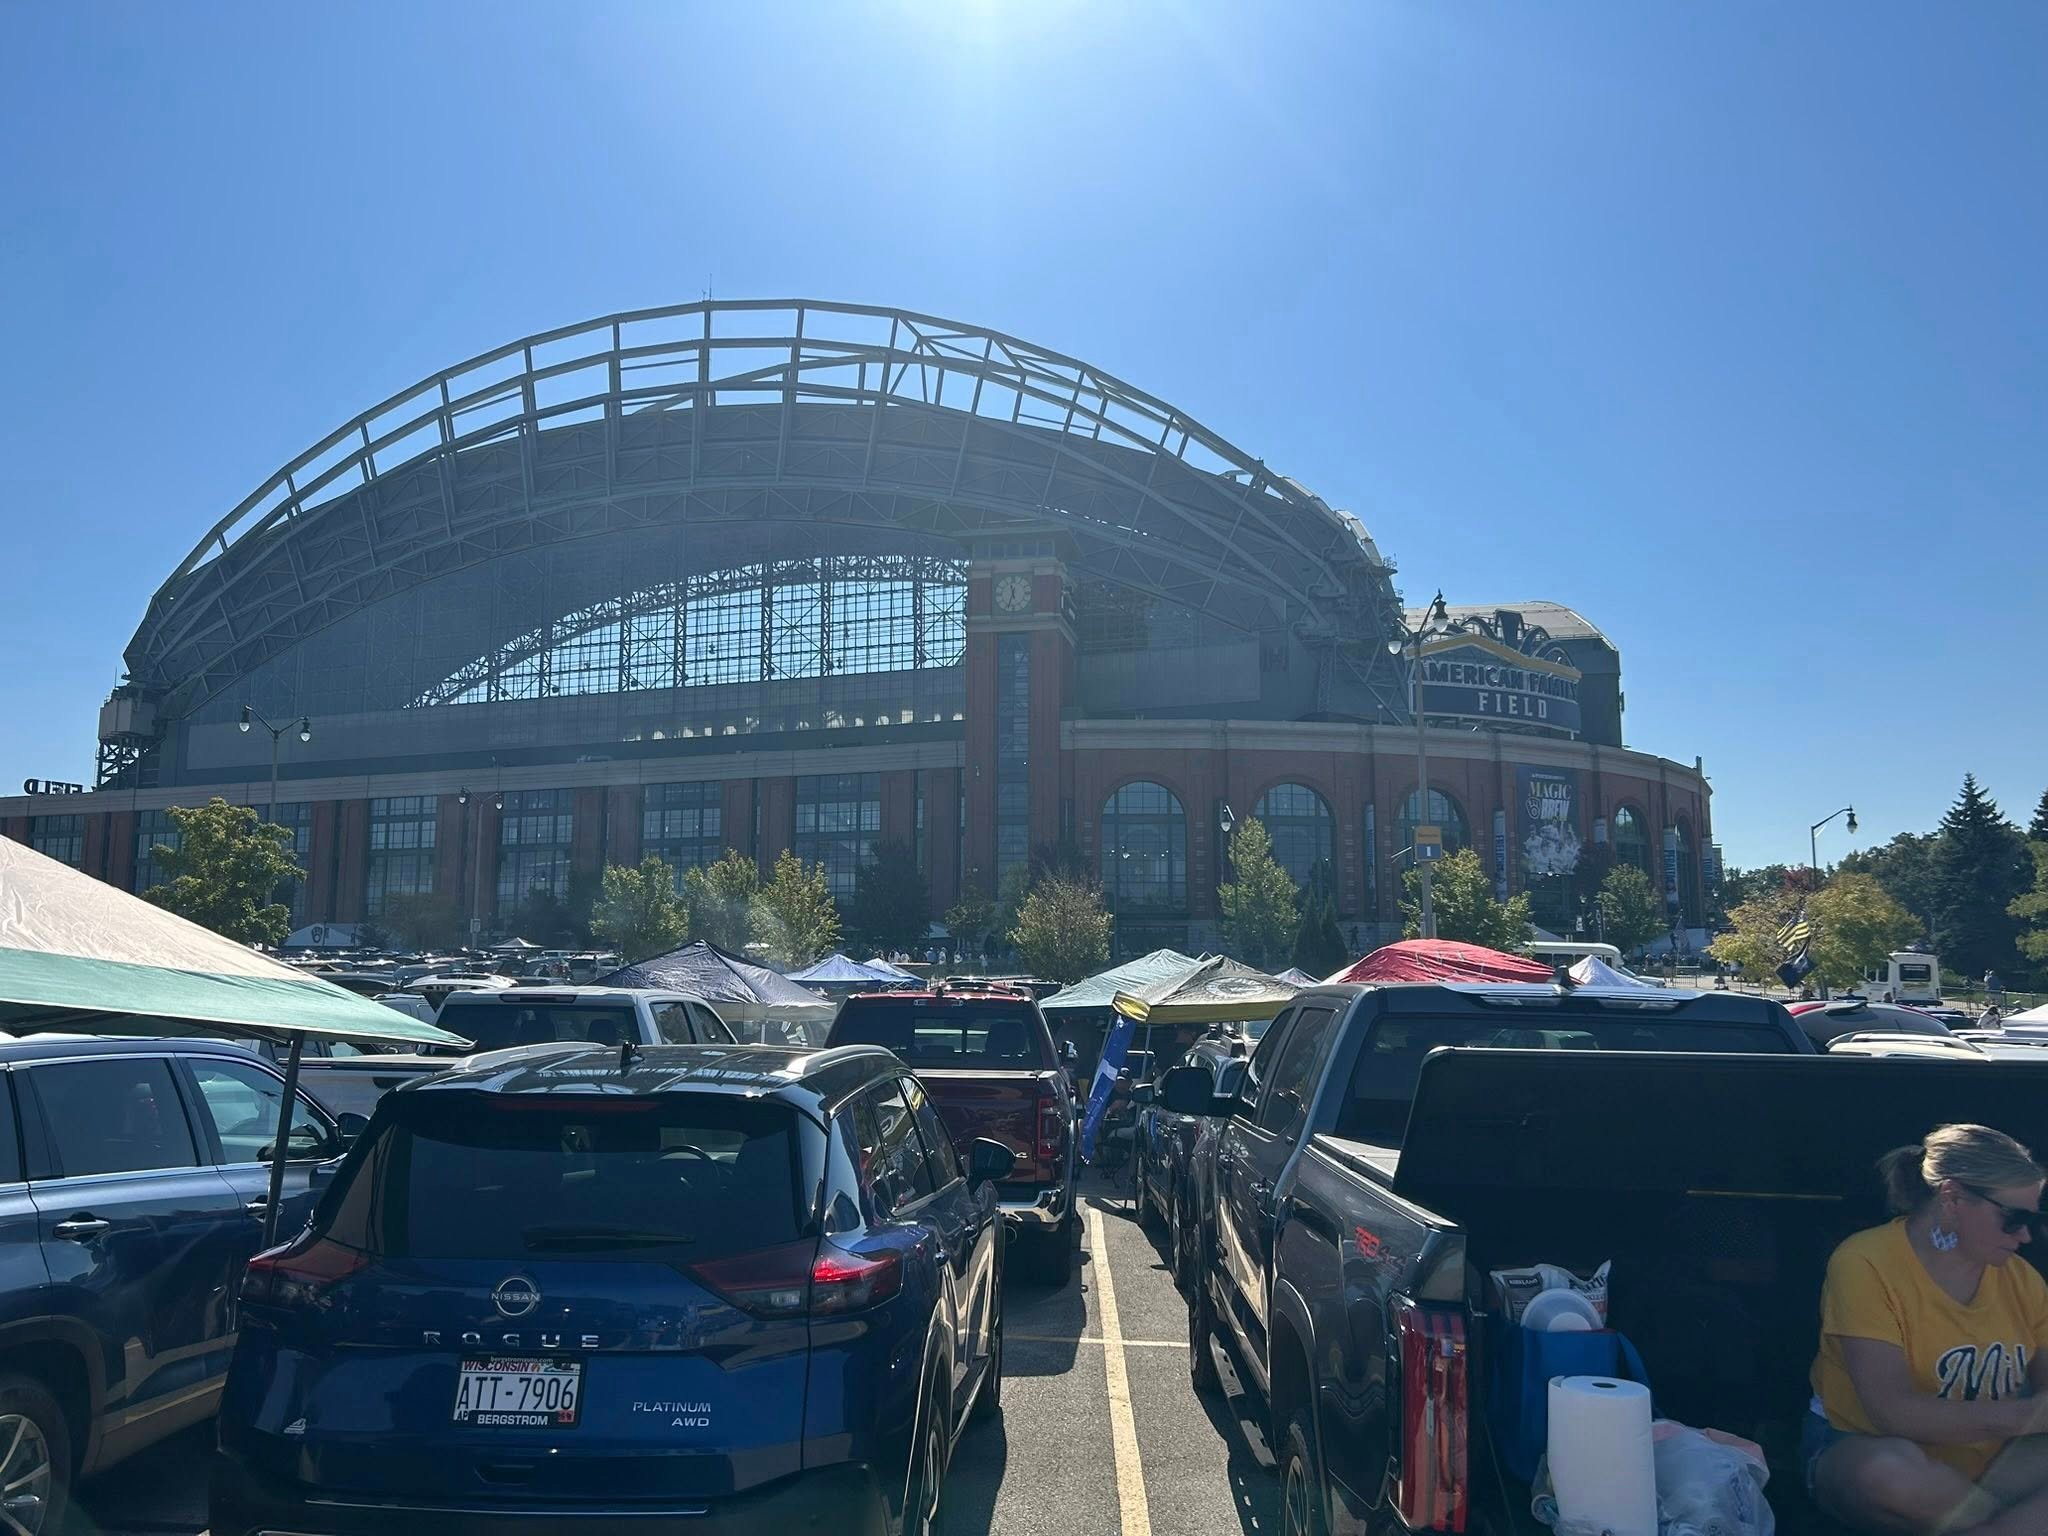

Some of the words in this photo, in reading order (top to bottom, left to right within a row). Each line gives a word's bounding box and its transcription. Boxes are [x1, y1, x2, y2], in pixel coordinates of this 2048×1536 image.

[1478, 692, 1548, 719] FIELD
[1528, 781, 1572, 800] MAGIC
[1540, 799, 1570, 821] BREW
[1355, 1225, 1382, 1258] TRD
[491, 1292, 540, 1301] NISSAN
[423, 1331, 600, 1348] ROGUE
[463, 1360, 531, 1372] WISCONSIN
[457, 1376, 574, 1410] ATT-7906
[633, 1401, 711, 1413] PLATINUM
[477, 1414, 548, 1426] BERGSTROM
[671, 1417, 710, 1427] AWD
